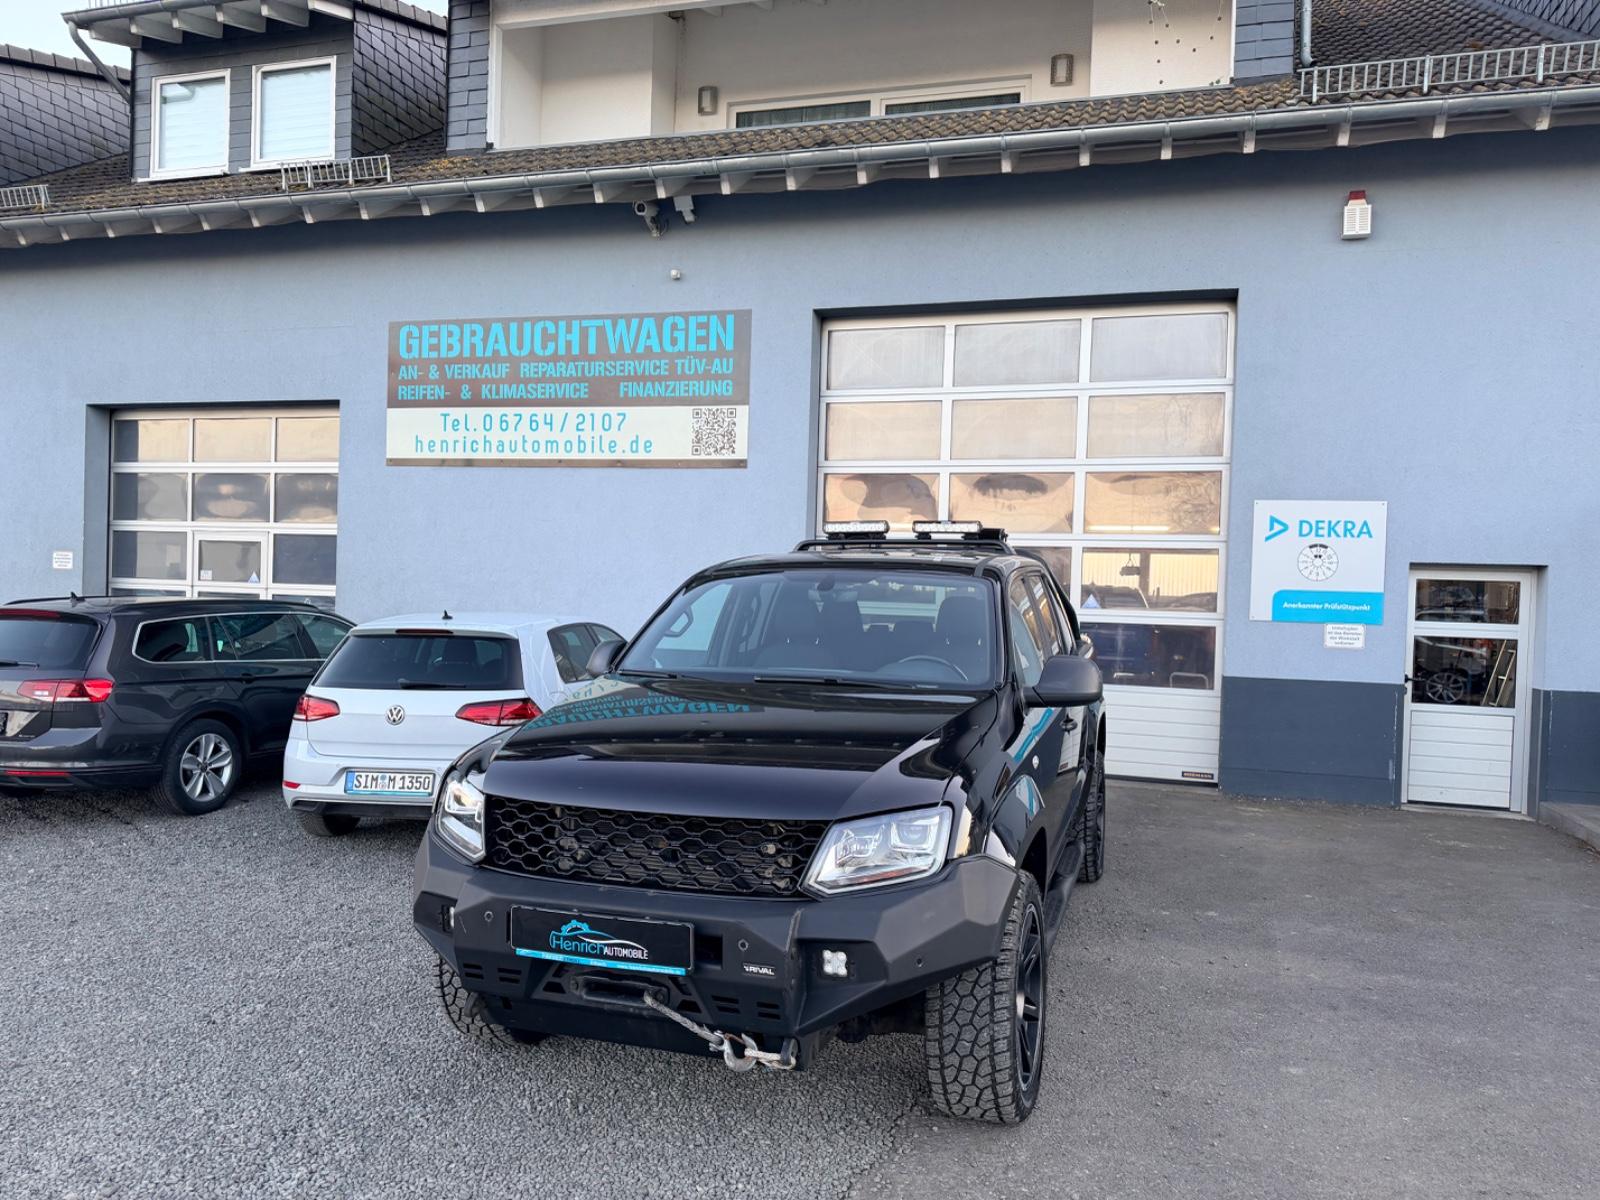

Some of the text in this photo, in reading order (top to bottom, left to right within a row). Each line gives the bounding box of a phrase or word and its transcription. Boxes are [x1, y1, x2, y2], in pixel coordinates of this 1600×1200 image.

[399, 313, 735, 359] GEBRAUCHTWAGEN
[398, 357, 735, 380] AN- & VERKAUF REPARATURSERVICE TÜV-AU
[397, 379, 734, 401] REIFEN- & KLIMASERVICE FINANZIERUNG
[414, 433, 654, 455] henrichautomobile.de
[1298, 519, 1373, 538] DEKRA
[354, 774, 431, 791] SIM M 1350
[551, 935, 649, 960] Henrich AUTOMOBILE
[749, 965, 775, 976] RIVAL
